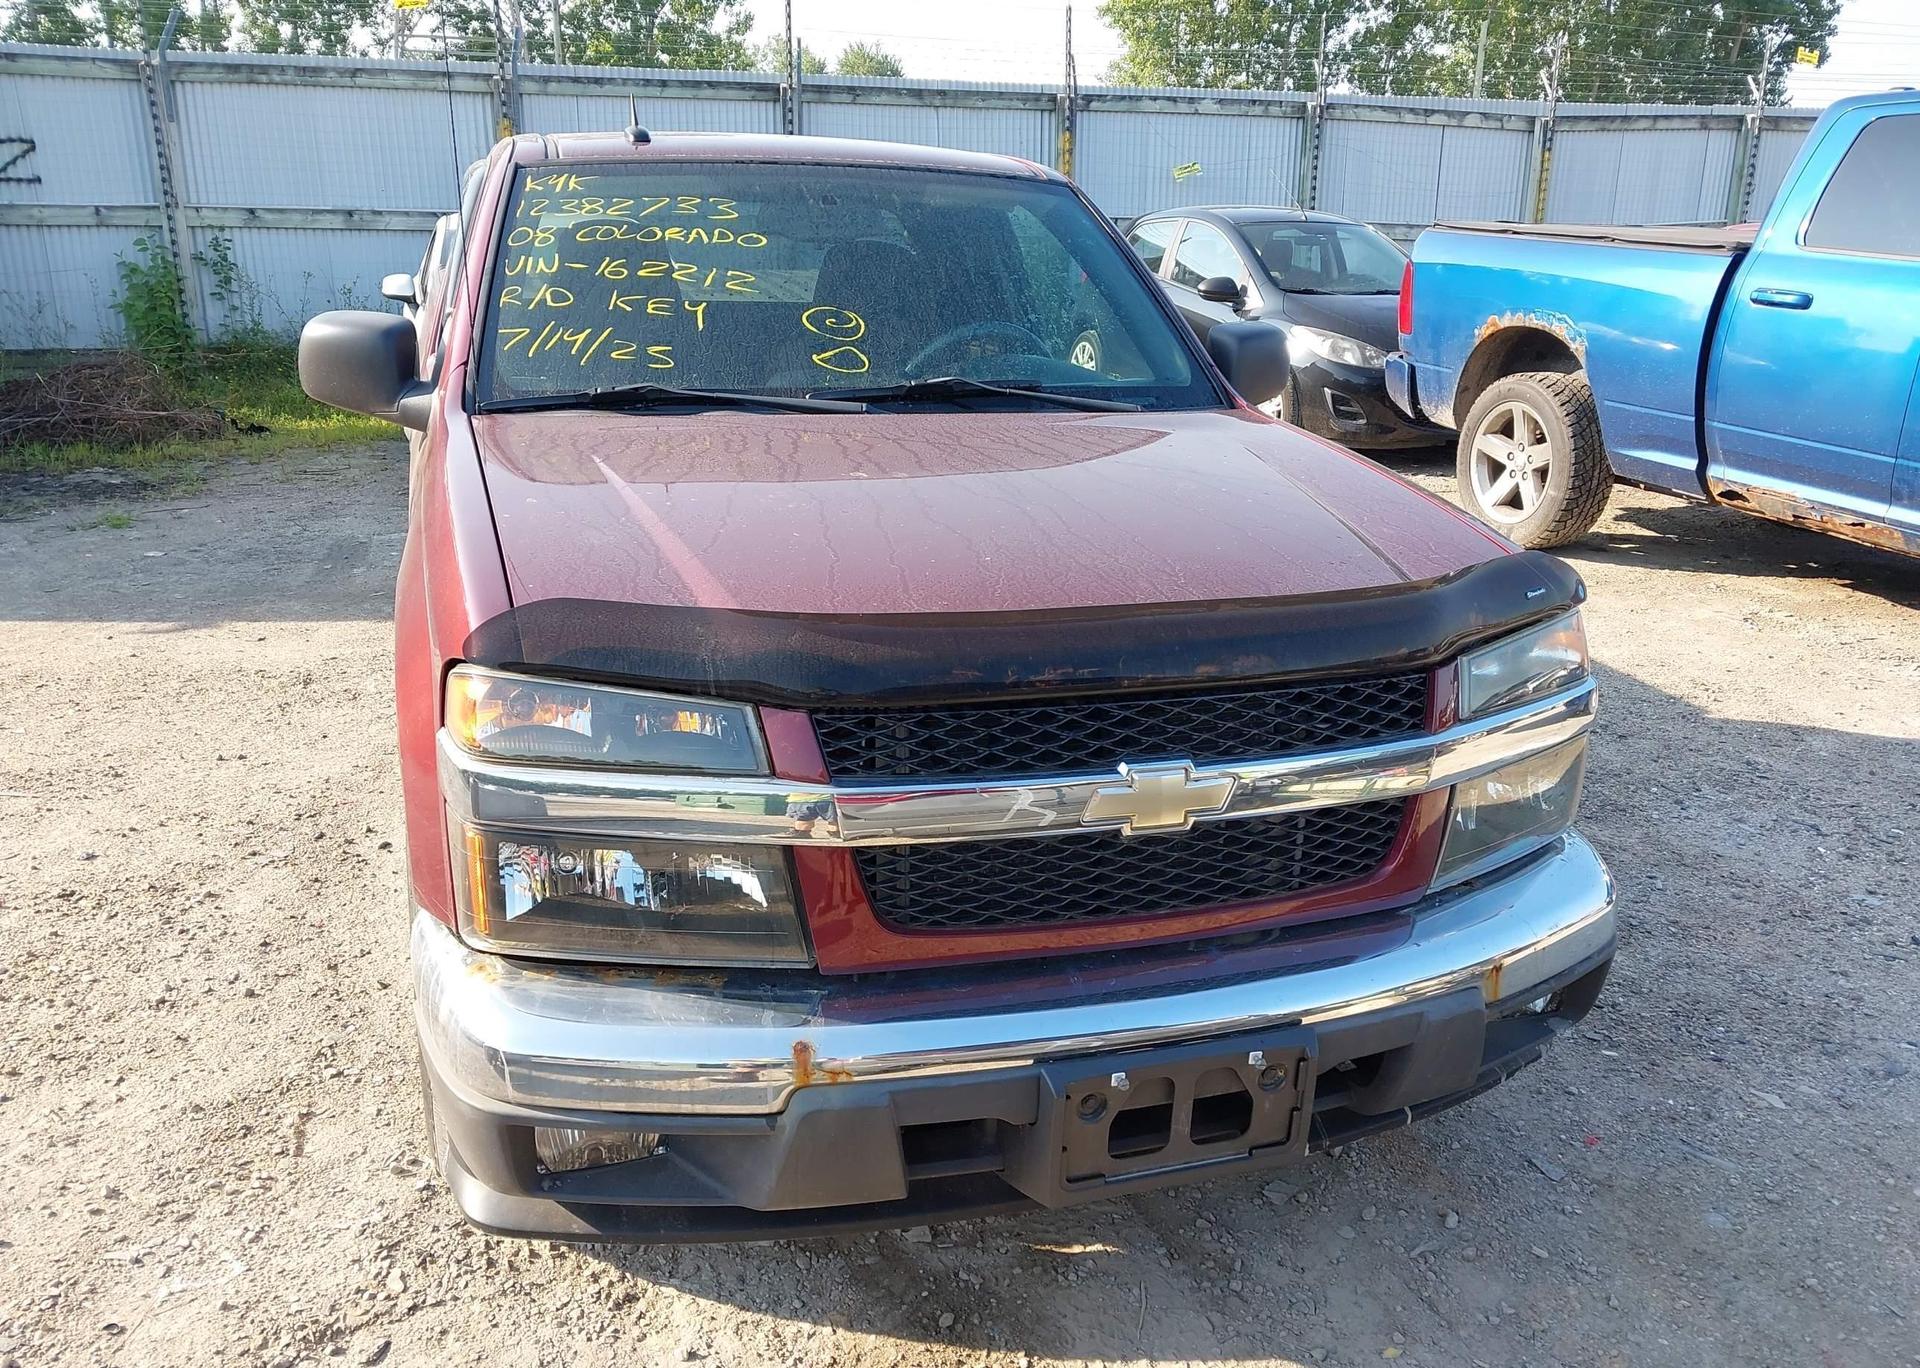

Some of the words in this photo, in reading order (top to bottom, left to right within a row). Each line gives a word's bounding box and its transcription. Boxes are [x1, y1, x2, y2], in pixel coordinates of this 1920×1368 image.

[517, 197, 739, 219] 12382733
[507, 226, 555, 247] 08
[576, 225, 768, 247] COLORADO
[608, 289, 708, 332] KEY
[498, 320, 675, 369] 7/14/25
